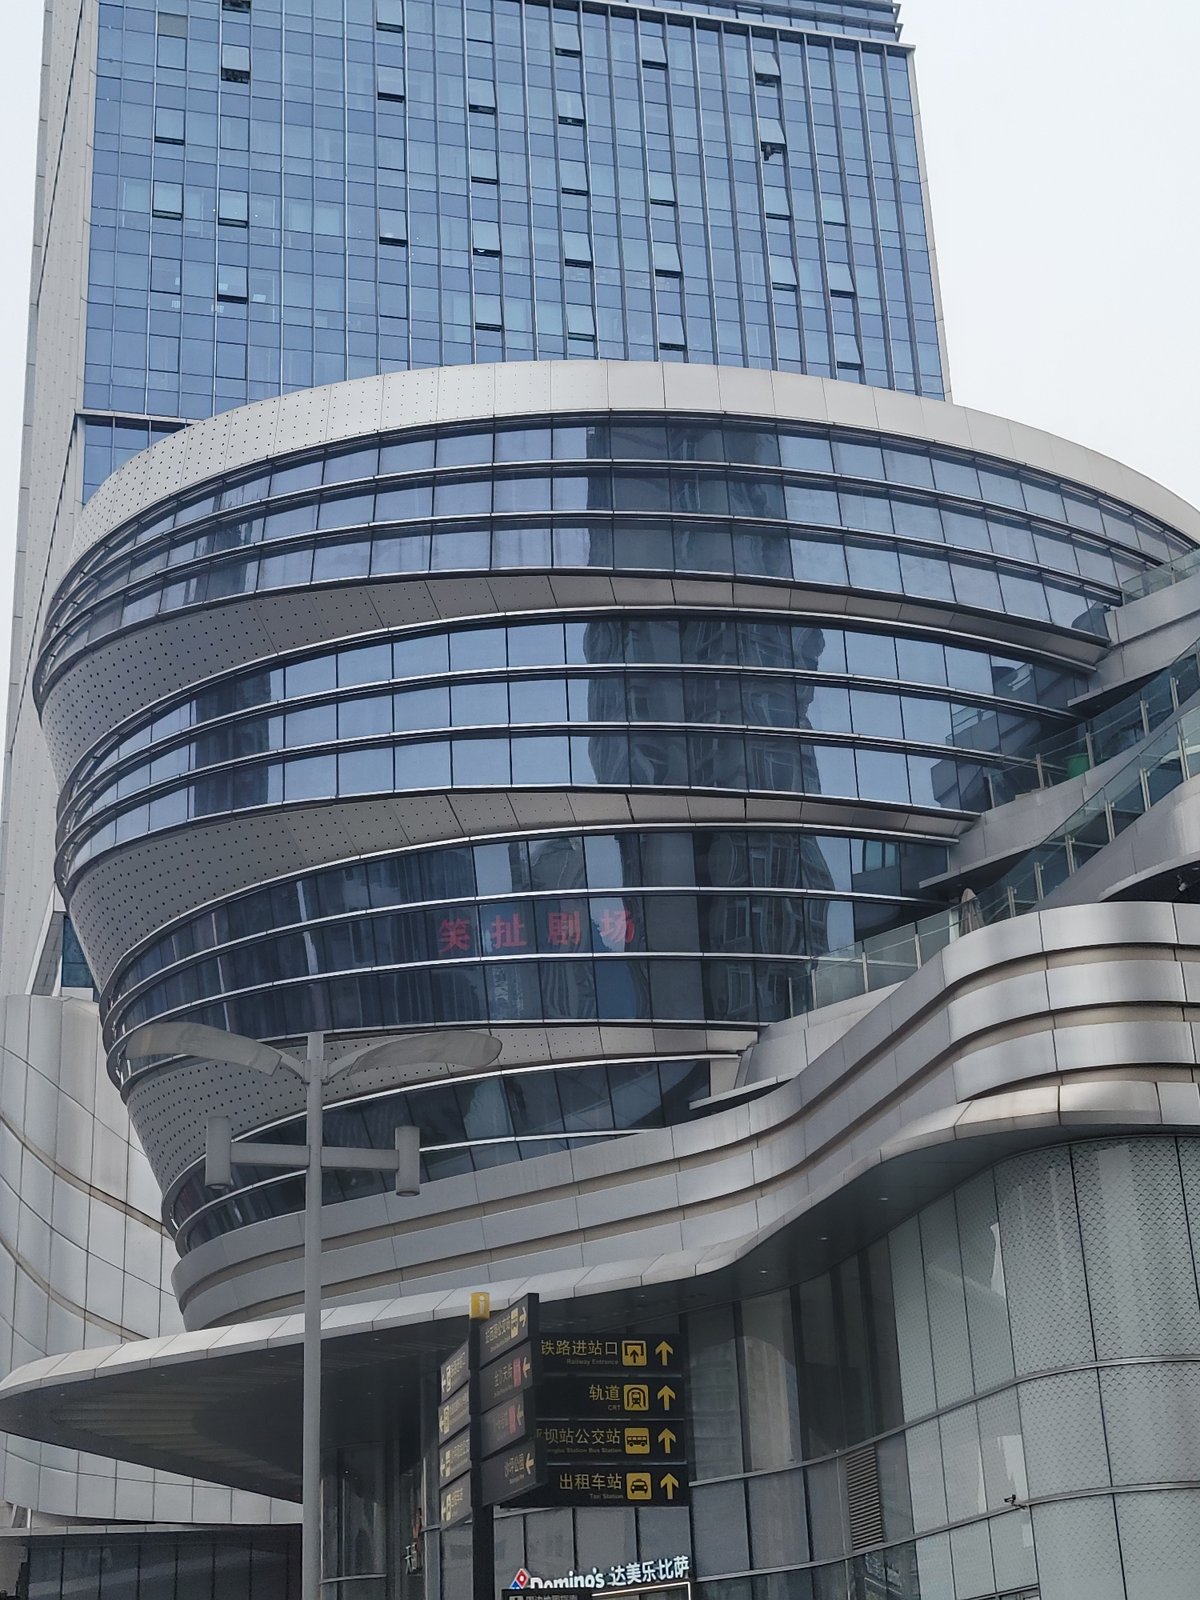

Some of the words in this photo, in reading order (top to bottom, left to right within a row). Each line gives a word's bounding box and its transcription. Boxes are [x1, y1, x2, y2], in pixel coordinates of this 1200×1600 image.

[438, 906, 635, 953] 笑扯剧场
[541, 1339, 618, 1356] 铁路进站口
[567, 1358, 590, 1366] Railway
[589, 1384, 621, 1401] 轨道
[560, 1473, 622, 1490] 出租车站
[530, 1567, 605, 1589] Domino's
[607, 1555, 690, 1586] 达美乐比萨
